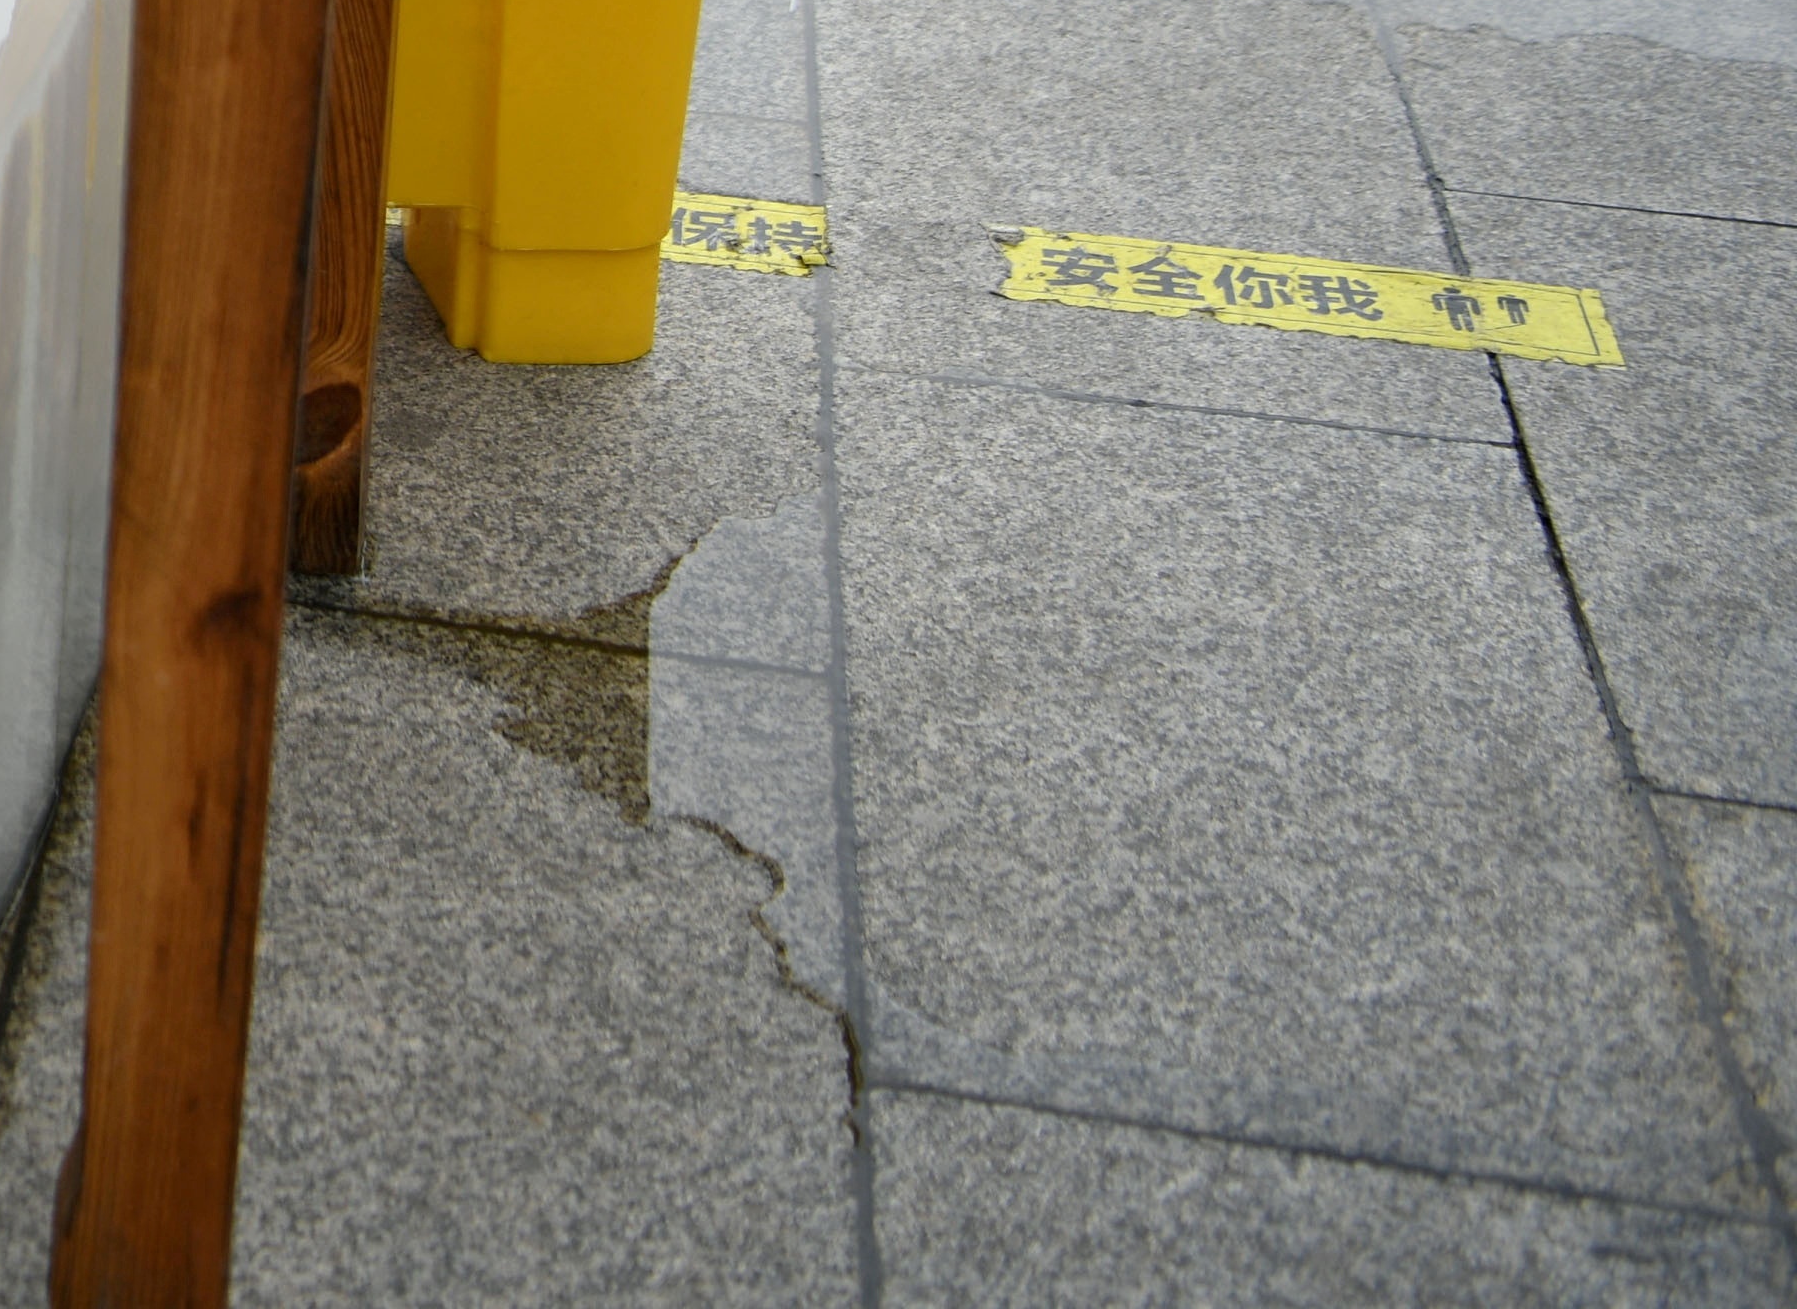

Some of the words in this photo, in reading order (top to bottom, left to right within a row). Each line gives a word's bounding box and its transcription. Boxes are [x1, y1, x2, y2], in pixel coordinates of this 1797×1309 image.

[671, 207, 823, 260] 保持
[1041, 247, 1384, 321] 安全你我
